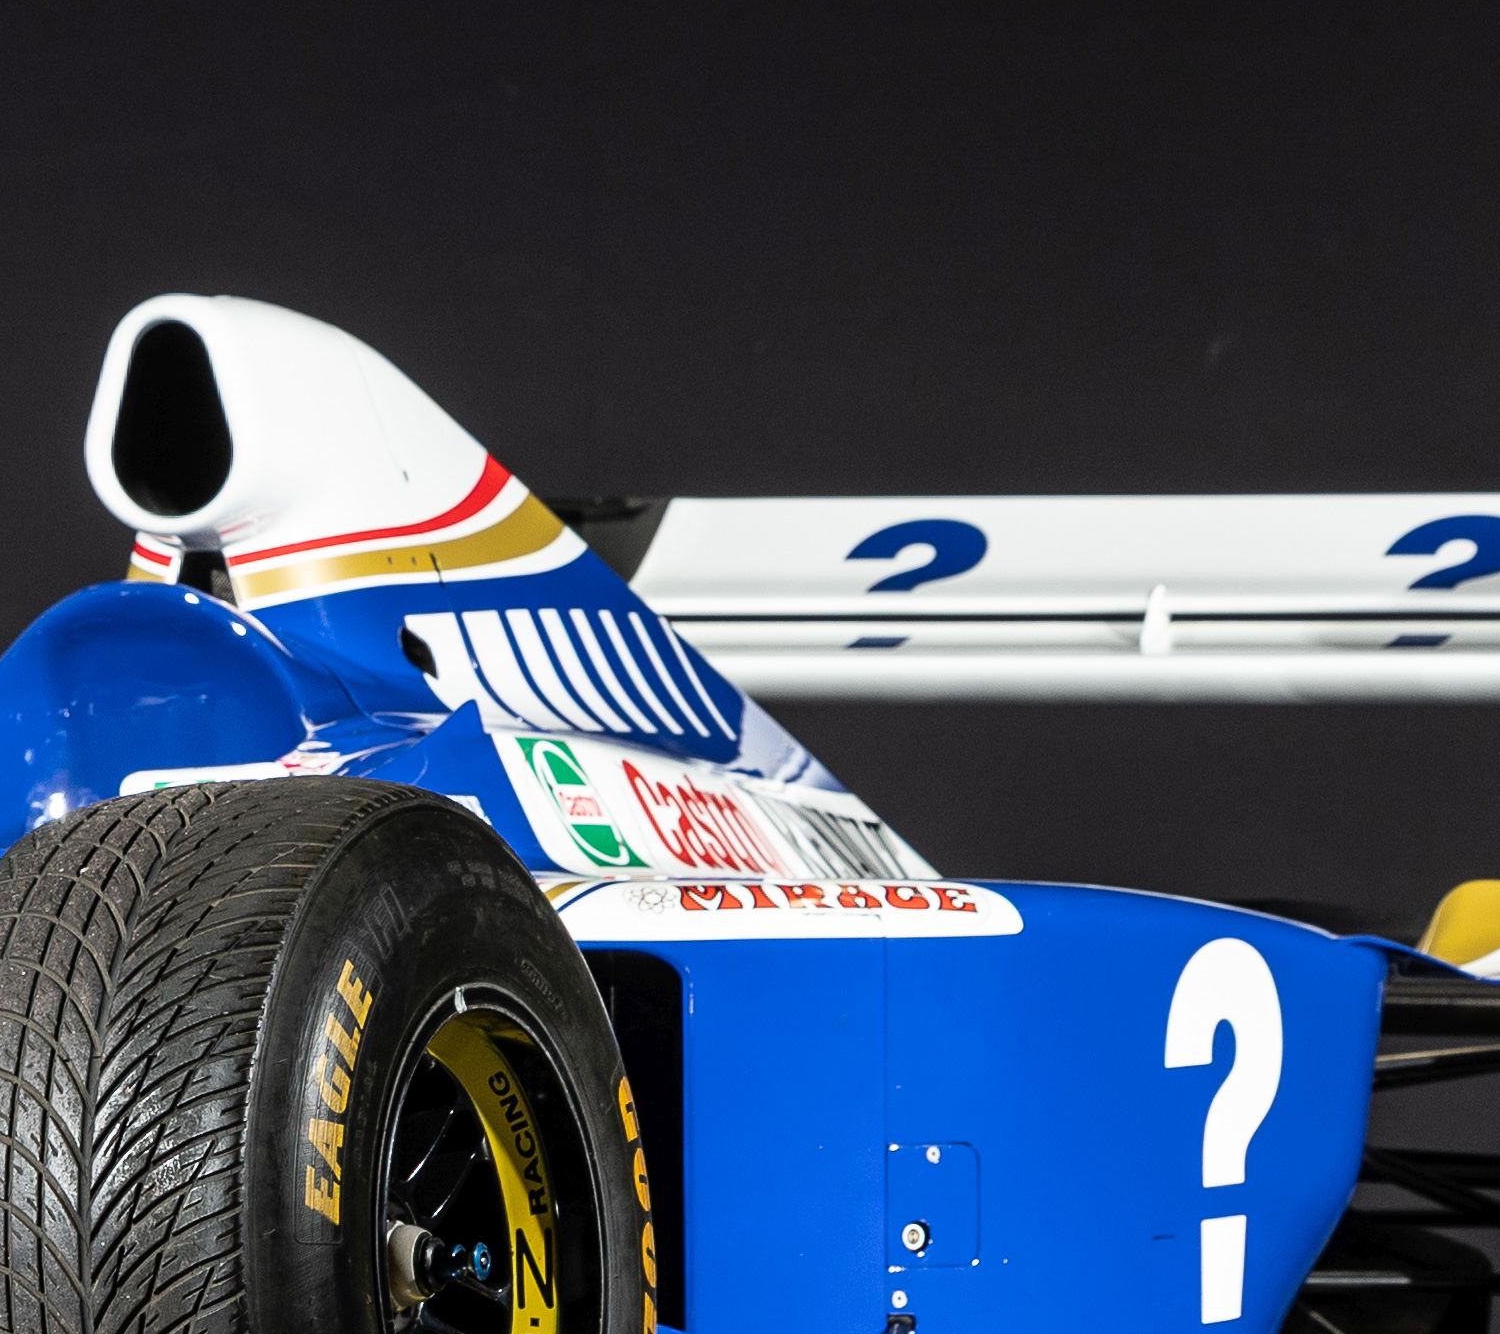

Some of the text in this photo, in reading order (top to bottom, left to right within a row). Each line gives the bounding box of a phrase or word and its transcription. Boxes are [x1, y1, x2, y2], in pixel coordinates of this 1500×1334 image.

[679, 883, 979, 914] MIRAGE
[304, 959, 373, 1226] EAGLE
[488, 1071, 549, 1217] RACING
